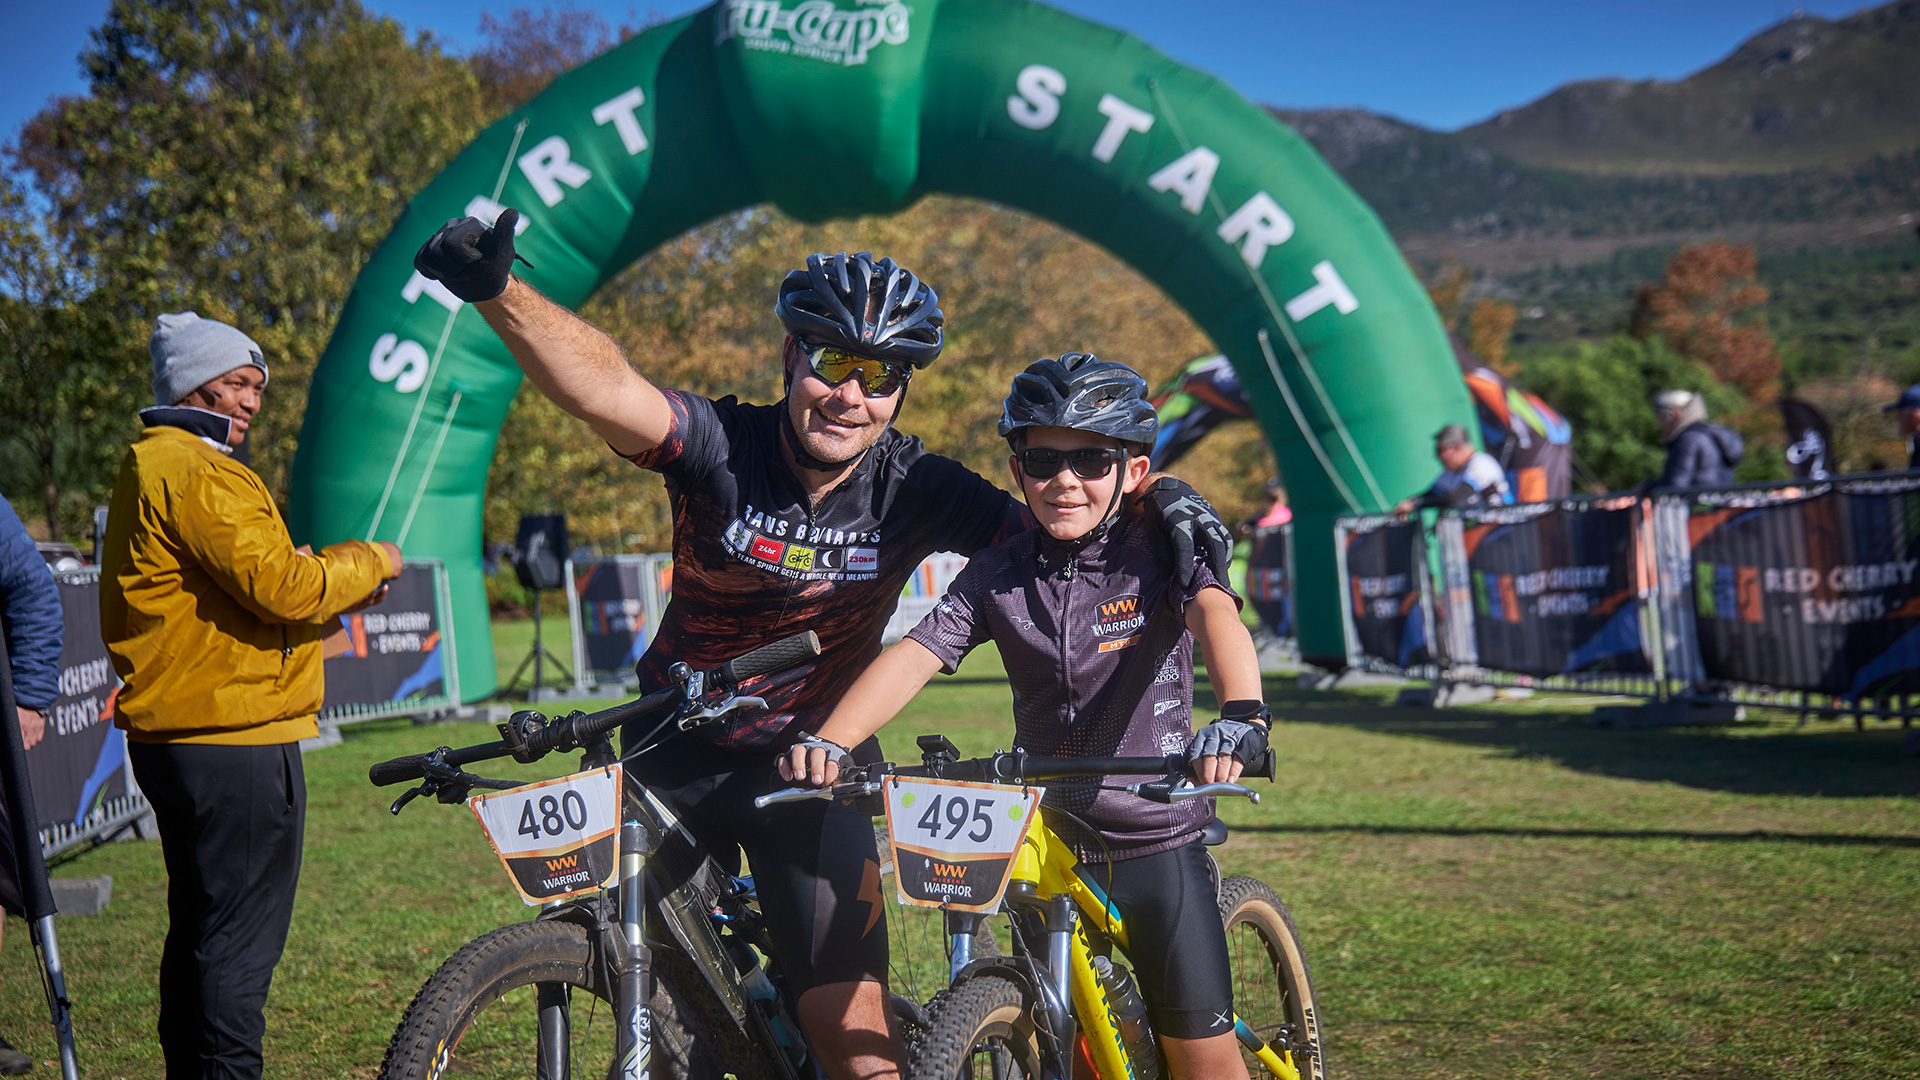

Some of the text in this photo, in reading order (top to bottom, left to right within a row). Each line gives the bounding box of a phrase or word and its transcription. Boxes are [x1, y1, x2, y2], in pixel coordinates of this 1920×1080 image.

[1006, 63, 1360, 323] START
[720, 535, 736, 557] WHERE
[737, 552, 756, 567] TEAM
[756, 561, 779, 574] SPIRIT
[800, 572, 805, 581] A
[806, 572, 827, 582] WHOLE
[828, 572, 844, 582] NEW
[846, 572, 879, 582] MEANING
[757, 544, 777, 556] 24hr
[849, 554, 876, 564] 230km
[1764, 557, 1918, 593] RED CHERRY
[1101, 598, 1138, 616] WW
[1101, 612, 1138, 623] WEEKEND
[1802, 595, 1885, 625] EVENTS
[363, 611, 431, 634] RED CHERRY
[1091, 613, 1146, 637] WARRIOR
[378, 632, 421, 654] EVENTS
[63, 656, 109, 697] CHERRY
[1154, 673, 1179, 684] ADDO
[56, 695, 99, 735] EVENTS
[518, 789, 588, 840] 480
[917, 794, 995, 843] 495
[546, 855, 578, 872] WW
[549, 867, 580, 878] WEEKEND
[934, 863, 967, 879] WW
[543, 871, 591, 890] WARRIOR
[924, 882, 972, 898] WARRIOR
[932, 877, 965, 885] WEEKEND
[1304, 1007, 1317, 1034] VEE
